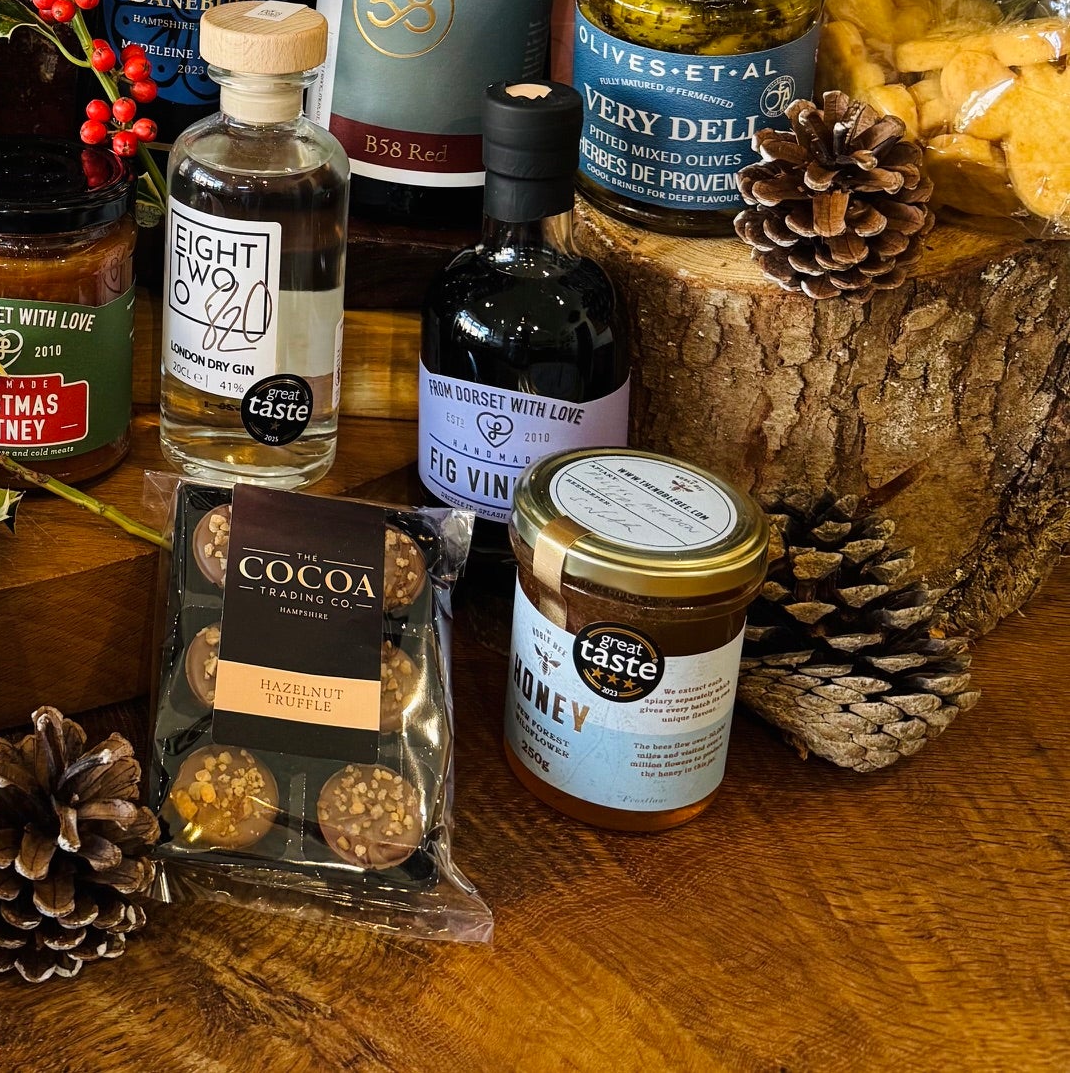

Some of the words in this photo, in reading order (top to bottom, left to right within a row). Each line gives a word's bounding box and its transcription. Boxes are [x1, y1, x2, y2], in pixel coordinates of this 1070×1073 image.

[133, 14, 198, 31] HAMPSHIRE,
[177, 64, 205, 75] 2023
[621, 78, 664, 91] MATURED
[676, 87, 734, 109] FERMENTED
[583, 82, 662, 137] VERY
[365, 135, 403, 158] B58
[407, 143, 448, 163] Red
[589, 124, 628, 152] PITTED
[631, 144, 681, 166] MIXED
[685, 153, 742, 168] OLIVES
[631, 163, 656, 185] DE
[611, 177, 644, 195] BRINED
[646, 188, 666, 199] FOR
[668, 193, 694, 203] DEEP
[696, 194, 740, 204] FLAVOUR
[175, 223, 258, 269] EIGHT
[175, 249, 236, 293] TWO
[19, 308, 58, 328] WITH
[60, 311, 96, 332] LOVE
[34, 344, 62, 358] 2010
[170, 339, 206, 368] LONDON
[208, 359, 231, 374] DRY
[233, 364, 255, 376] GIN
[219, 380, 245, 394] 41%
[266, 387, 301, 402] great
[249, 395, 309, 422] taste
[456, 385, 506, 410] DORSET
[510, 396, 546, 418] WITH
[549, 404, 585, 425] LOVE
[430, 445, 457, 484] FIG
[238, 556, 376, 599] COCOA
[259, 585, 326, 605] TRADING
[329, 597, 354, 610] CO.
[279, 606, 329, 621] HAMPSHIRE
[599, 635, 644, 657] great
[580, 639, 657, 681] taste
[260, 678, 345, 700] HAZELNUT
[265, 692, 332, 713] TRUFFLE
[513, 651, 591, 733] HONEY
[601, 685, 618, 697] 2023
[521, 739, 551, 773] 250g
